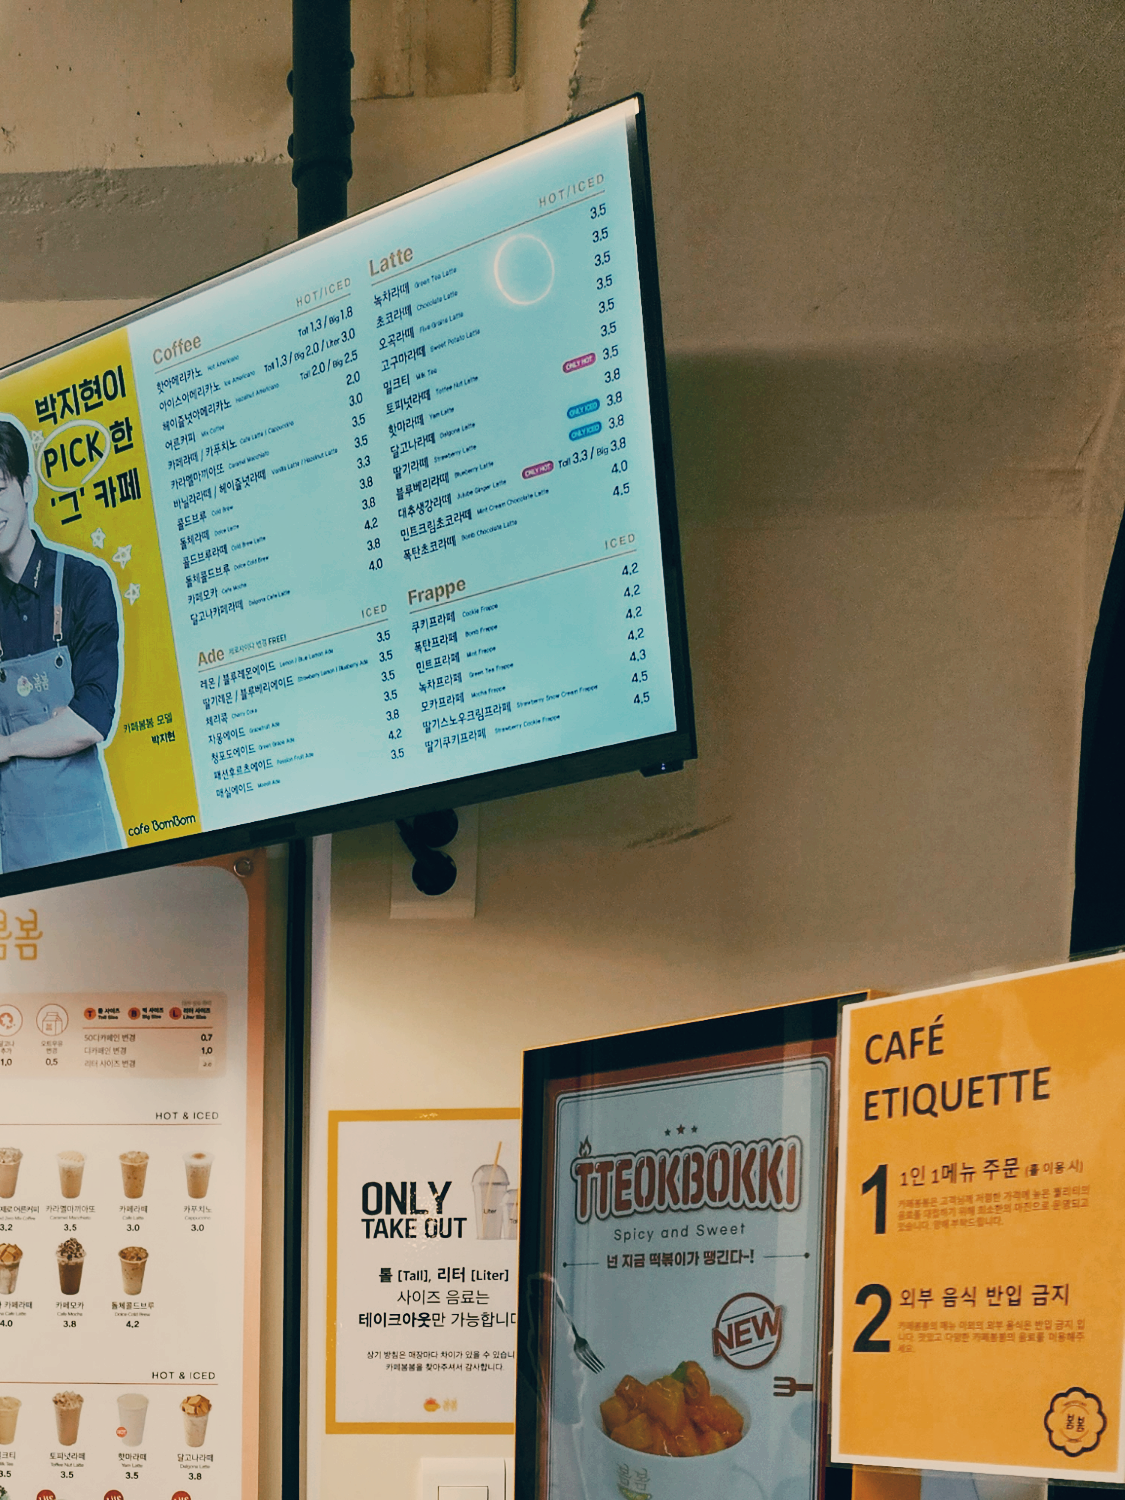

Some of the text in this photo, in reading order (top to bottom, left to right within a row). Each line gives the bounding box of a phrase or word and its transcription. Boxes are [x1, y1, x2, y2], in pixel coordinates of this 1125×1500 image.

[538, 173, 604, 208] HOT/ICED
[590, 203, 607, 219] 3.5
[369, 246, 414, 277] Latte
[296, 277, 351, 308] HOT/ICED
[374, 282, 410, 307] 녹차라떼
[153, 335, 202, 365] Coffee
[156, 367, 203, 394] 핫아메리카노
[383, 373, 410, 395] 밀크티
[35, 365, 126, 425] 박지현이
[43, 417, 133, 478] PICK 한
[165, 432, 196, 450] 어른커피
[393, 457, 429, 480] 딸기라떼
[93, 468, 141, 508] 카페
[177, 510, 207, 531] 콜드브루
[605, 534, 635, 550] ICED
[622, 563, 639, 576] 4.2
[408, 578, 466, 605] Frappe
[361, 604, 387, 618] ICED
[412, 611, 455, 633] 쿠키프라페
[197, 649, 225, 666] Ade
[157, 712, 173, 725] 모델
[151, 730, 175, 746] 박지현
[216, 782, 253, 798] 매실에이드
[128, 815, 196, 836] cafe BomBom
[865, 1014, 944, 1064] CAFÉ
[864, 1066, 1051, 1122] ETIQUETTE
[155, 1112, 178, 1120] HOT
[193, 1111, 219, 1120] ICED
[573, 1143, 798, 1219] TTEOKBOKKI
[361, 1181, 452, 1216] ONLY
[861, 1164, 888, 1234] 1
[900, 1166, 925, 1186] 1인
[931, 1162, 976, 1184] 1메뉴
[983, 1157, 1020, 1181] 주문
[1043, 1160, 1065, 1175] 이용
[1069, 1159, 1083, 1174] 시)
[119, 1205, 147, 1214] 카페라떼
[126, 1224, 141, 1232] 3.0
[361, 1217, 468, 1239] TAKE OUT
[613, 1223, 746, 1243] Spicy and Sweet
[607, 1254, 618, 1268] 넌
[622, 1253, 645, 1268] 지금
[649, 1251, 699, 1268] 떡볶이가
[379, 1266, 509, 1284] 톨 [Tall], 리터 [Liter]
[397, 1289, 490, 1305] 사이즈 음료는
[358, 1312, 445, 1328] 테이크아웃만
[852, 1283, 893, 1353] 2
[900, 1288, 933, 1309] 외부
[941, 1286, 977, 1308] 음식
[986, 1284, 1022, 1307] 반입
[1031, 1284, 1070, 1306] 금지
[713, 1306, 780, 1358] NEW
[367, 1351, 382, 1359] 상기
[384, 1351, 406, 1359] 방침은
[409, 1351, 438, 1359] 매장마다
[441, 1351, 463, 1359] 차이가
[465, 1351, 480, 1359] 있을
[151, 1372, 175, 1380] HOT
[189, 1372, 215, 1380] ICED
[425, 1363, 463, 1372] 찾아주셔서
